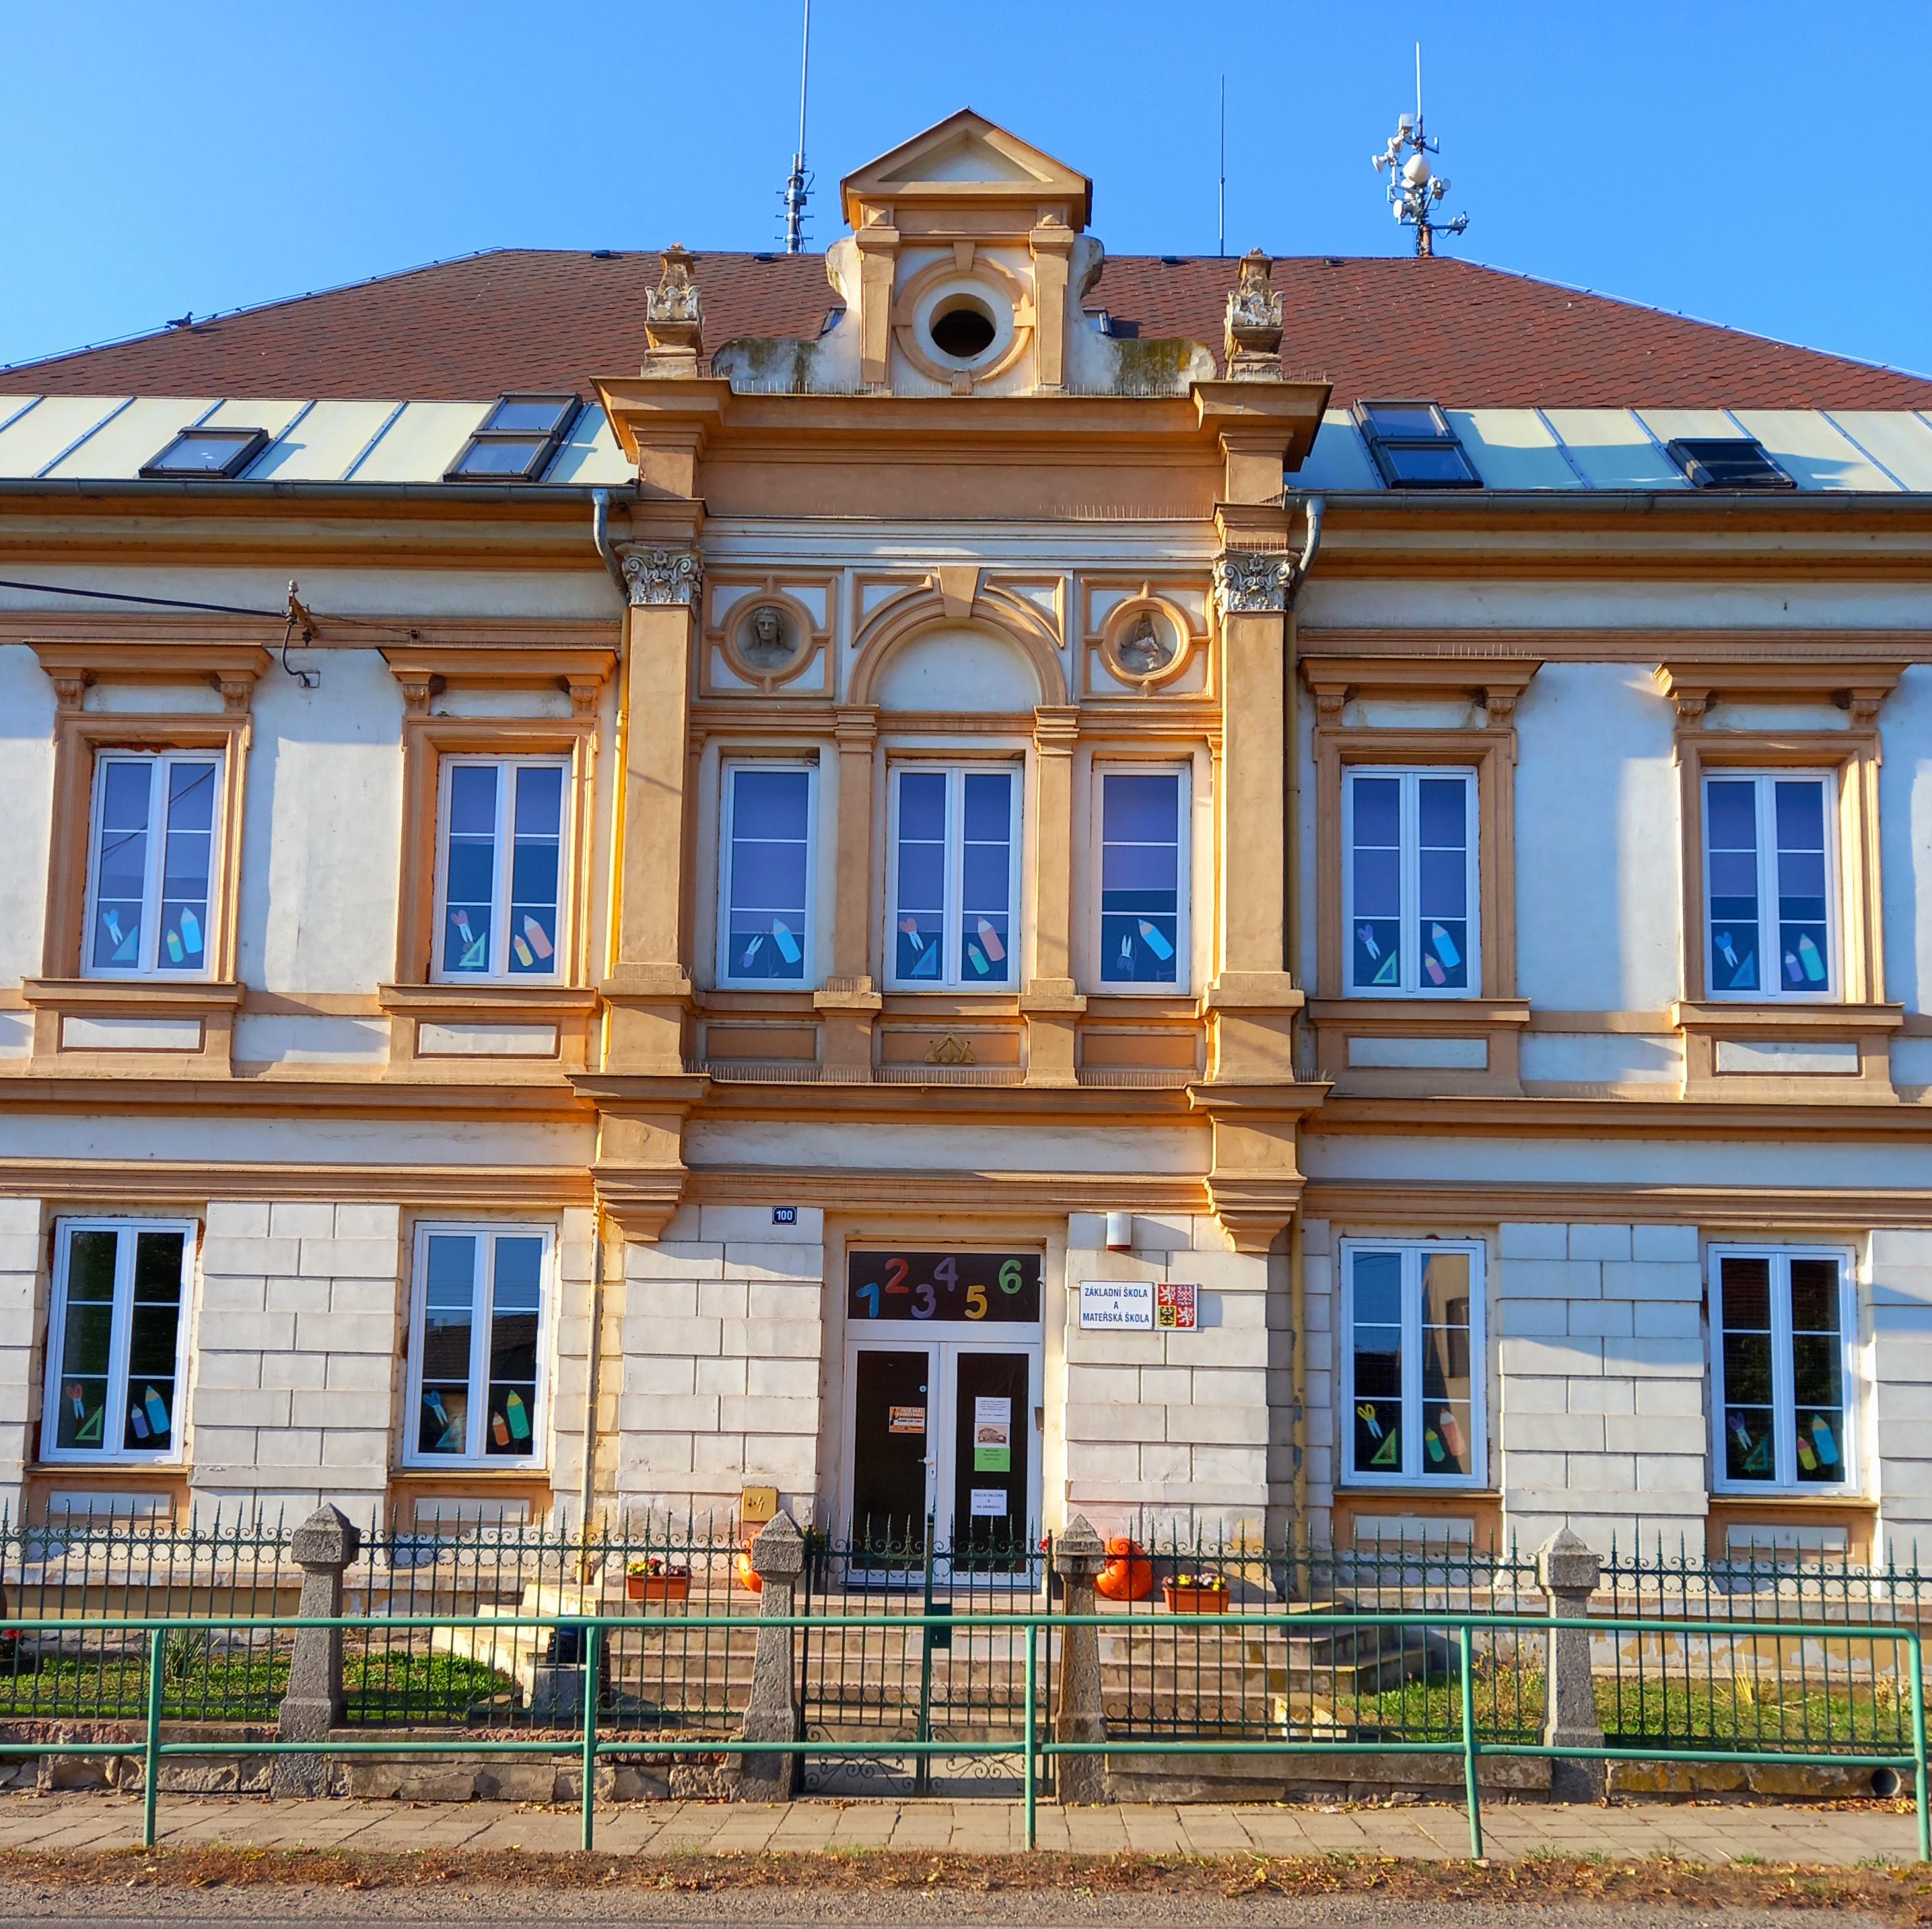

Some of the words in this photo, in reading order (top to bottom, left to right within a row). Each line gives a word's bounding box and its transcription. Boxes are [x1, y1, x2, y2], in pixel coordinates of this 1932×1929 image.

[775, 1210, 793, 1220] 100
[856, 1283, 880, 1318] 1
[885, 1258, 909, 1293] 2
[911, 1284, 936, 1319] 3
[934, 1257, 959, 1291] 4
[965, 1285, 988, 1319] 5
[999, 1260, 1022, 1294] 6
[1084, 1286, 1122, 1297] ZÁKLADNÍ
[1124, 1287, 1148, 1297] ŠKOLA
[1113, 1301, 1119, 1310] A
[1082, 1312, 1123, 1322] MATEŘSKÁ
[1125, 1312, 1149, 1322] ŠKOLA
